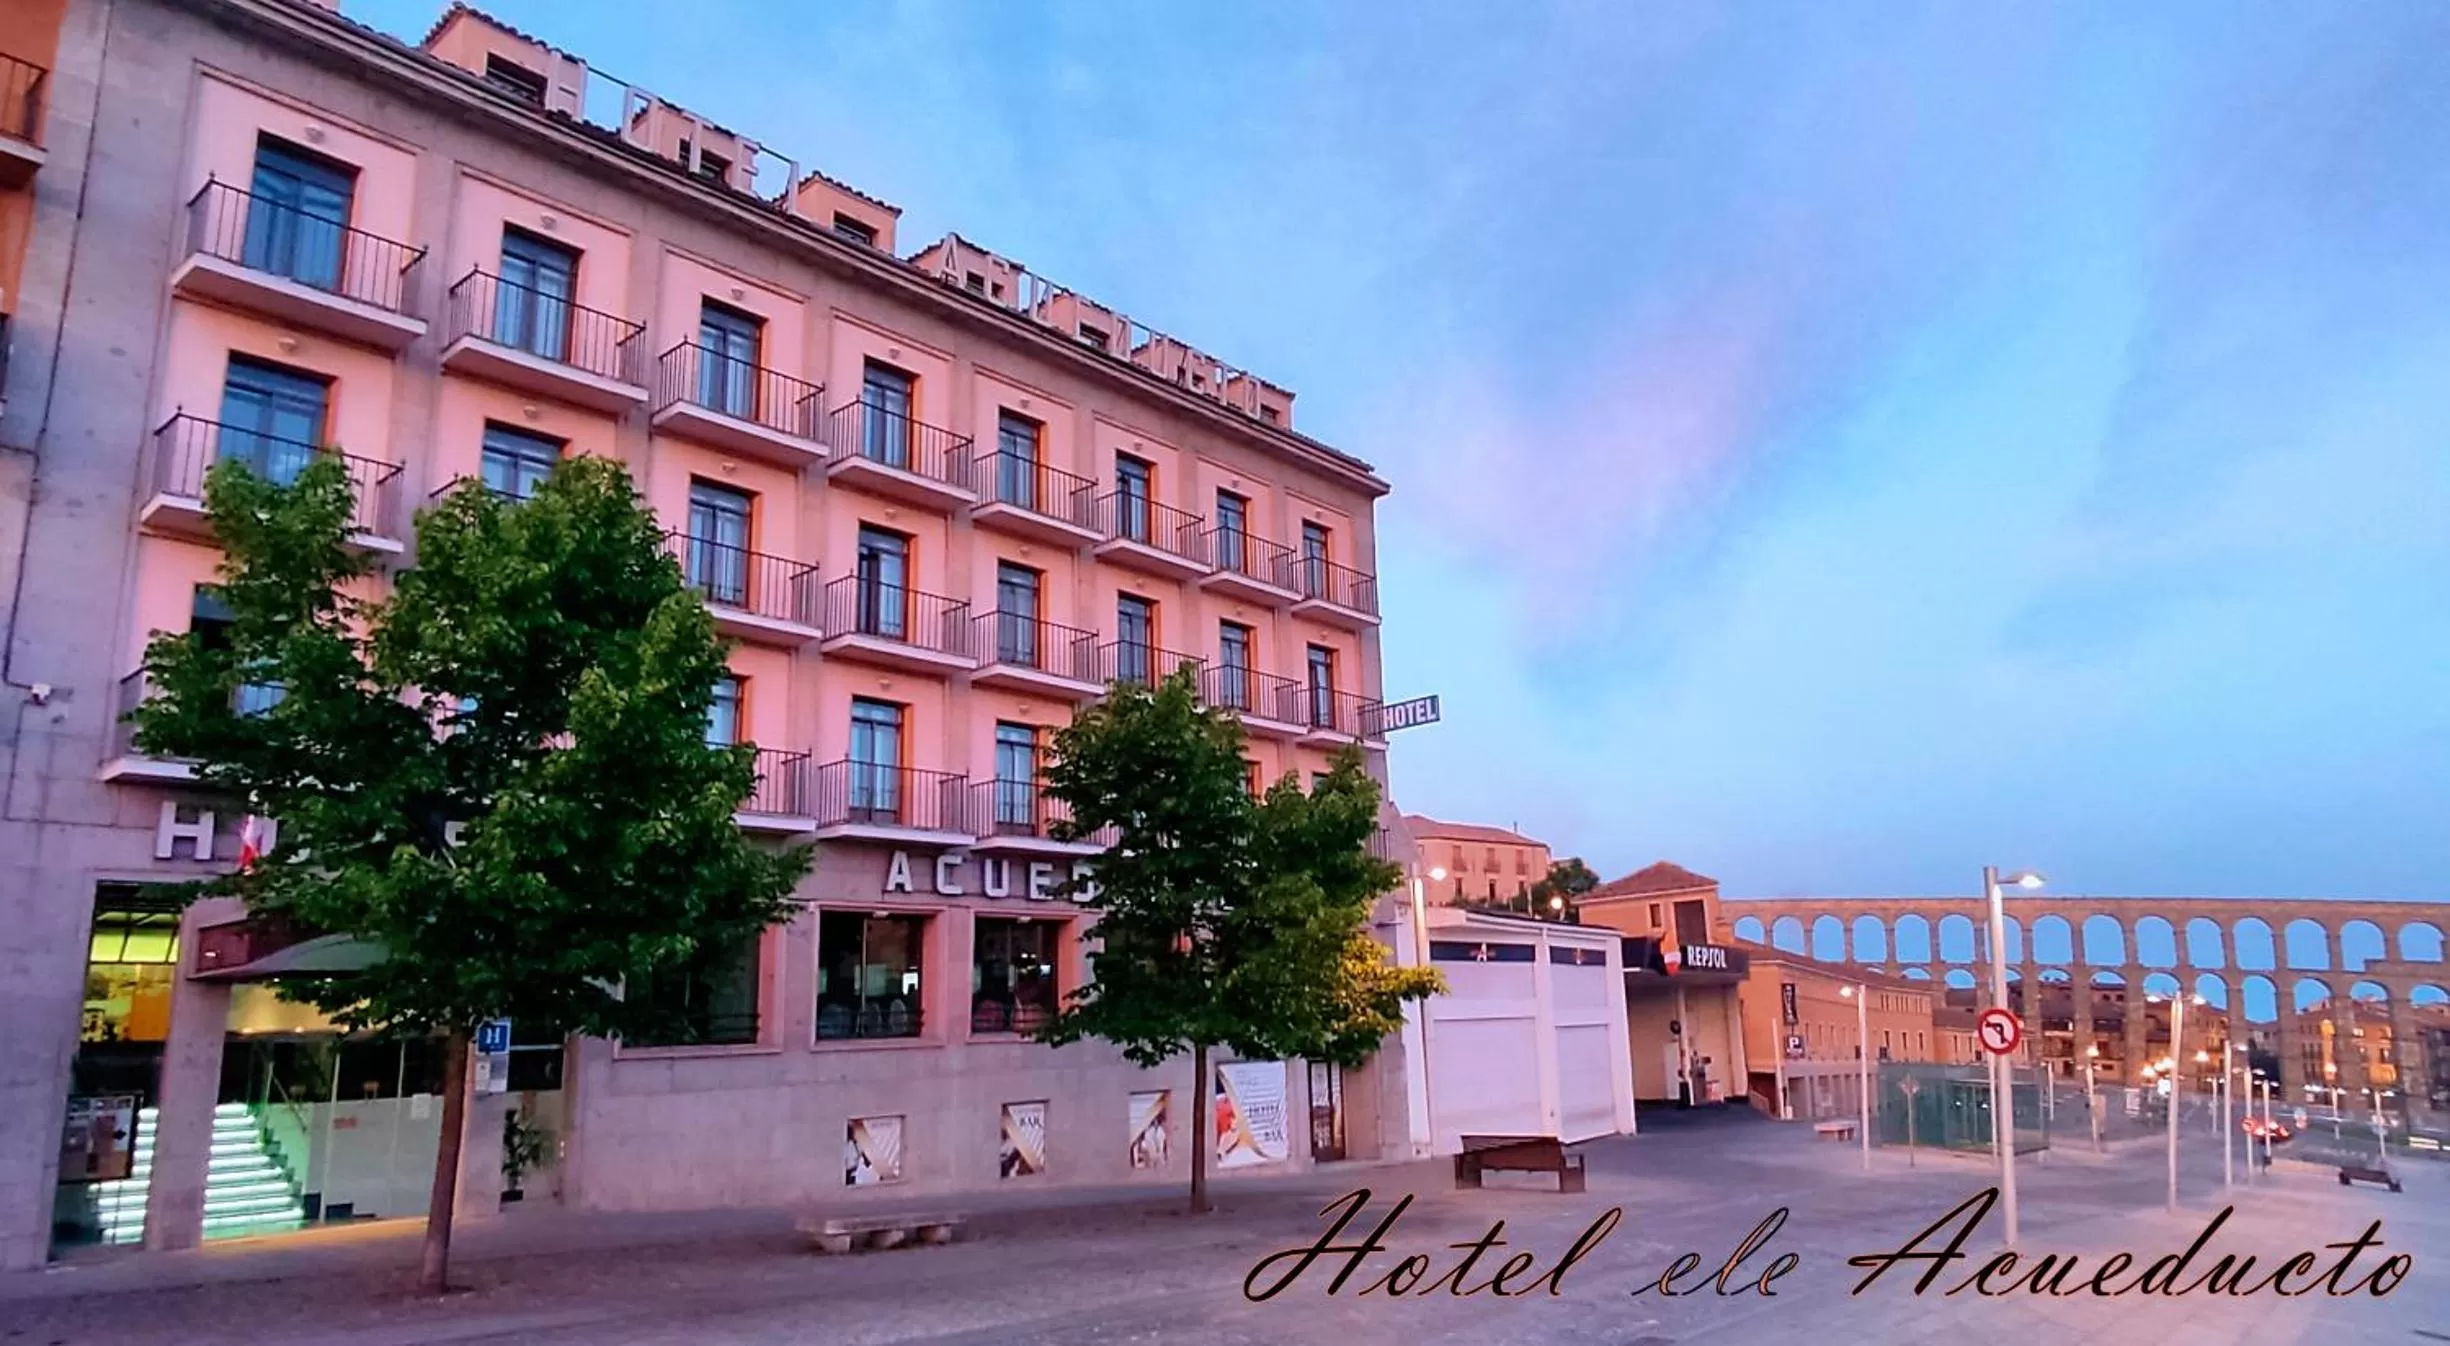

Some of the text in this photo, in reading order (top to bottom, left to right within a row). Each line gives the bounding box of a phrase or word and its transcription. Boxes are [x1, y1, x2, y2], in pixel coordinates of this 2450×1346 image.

[544, 48, 813, 226] HOTEL
[1383, 699, 1437, 729] HOTEL
[885, 850, 1105, 903] ACUED
[1686, 944, 1728, 968] REPSOL
[1789, 1036, 1800, 1050] P
